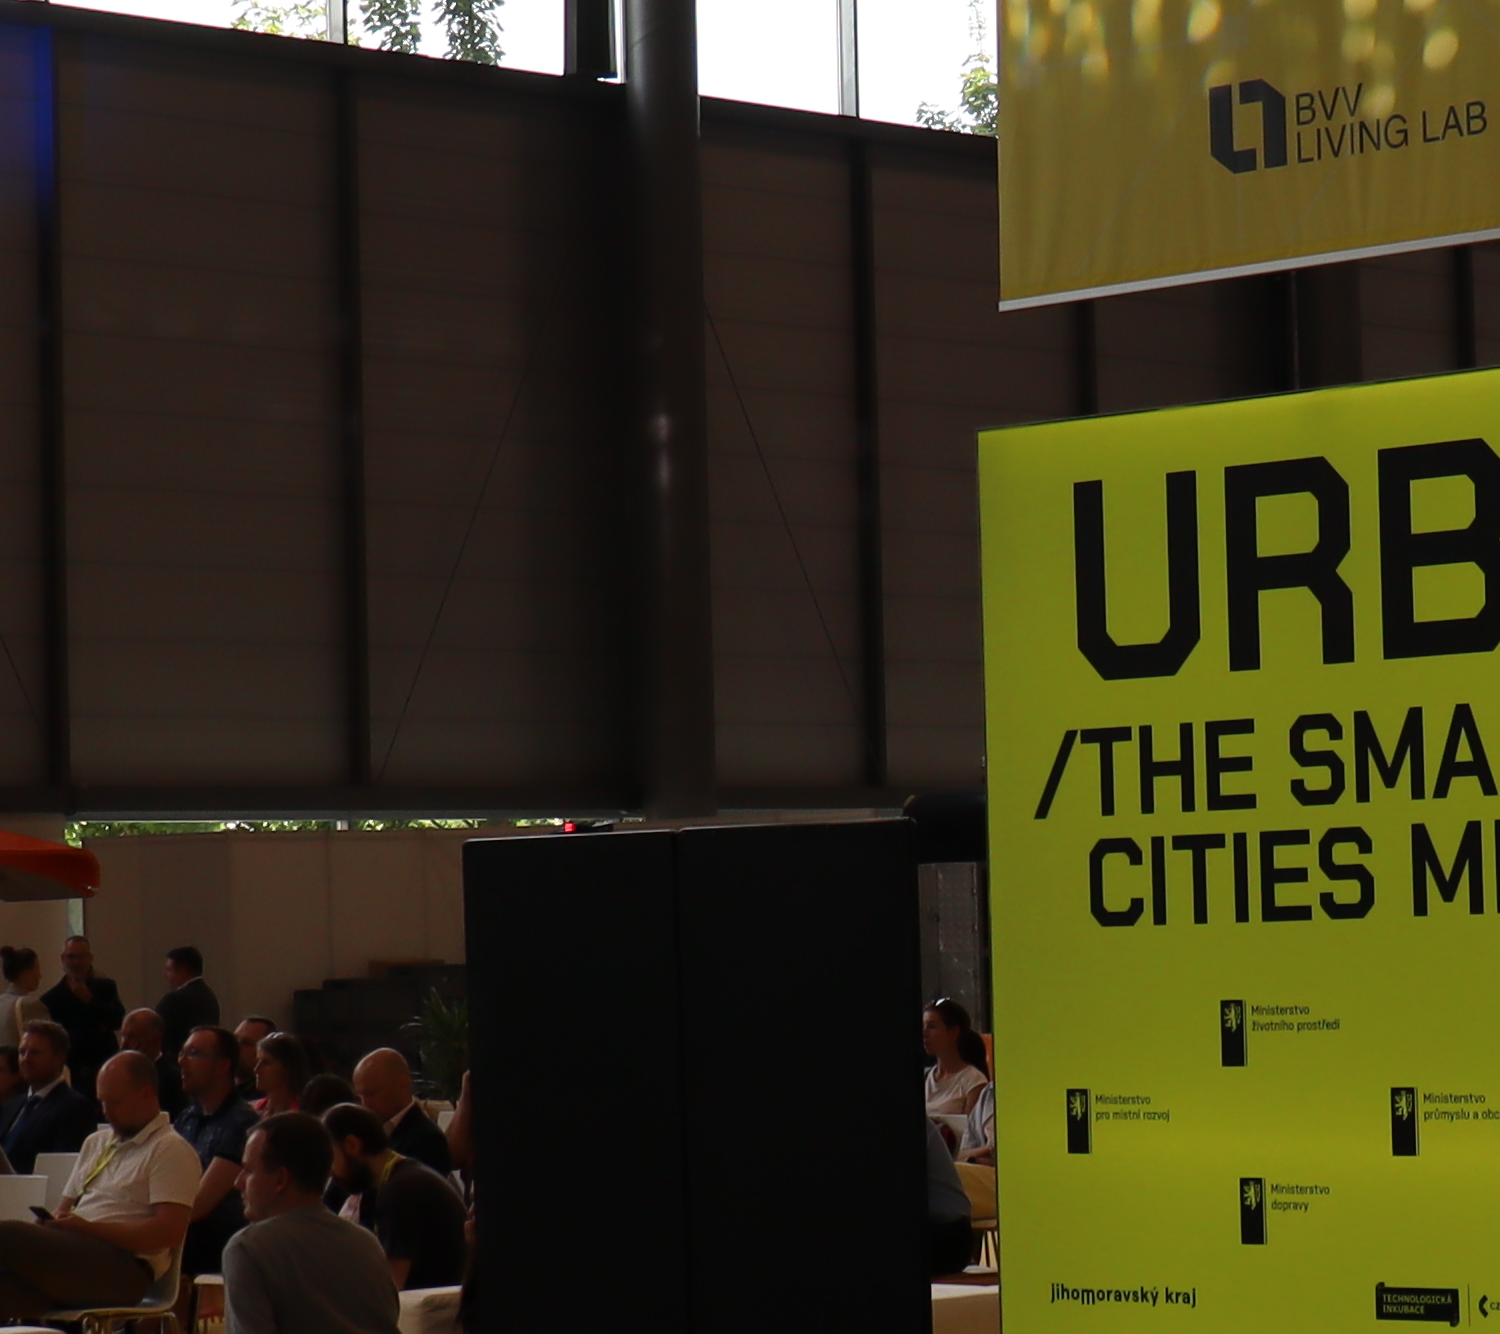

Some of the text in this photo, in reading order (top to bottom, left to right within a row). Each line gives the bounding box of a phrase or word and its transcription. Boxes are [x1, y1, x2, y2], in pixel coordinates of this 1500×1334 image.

[1295, 83, 1364, 126] BVV
[1298, 100, 1488, 165] LIVING LAB
[1033, 718, 1257, 819] /THE
[1089, 826, 1375, 927] CITIES
[1050, 1282, 1196, 1308] jihomoravský kraj
